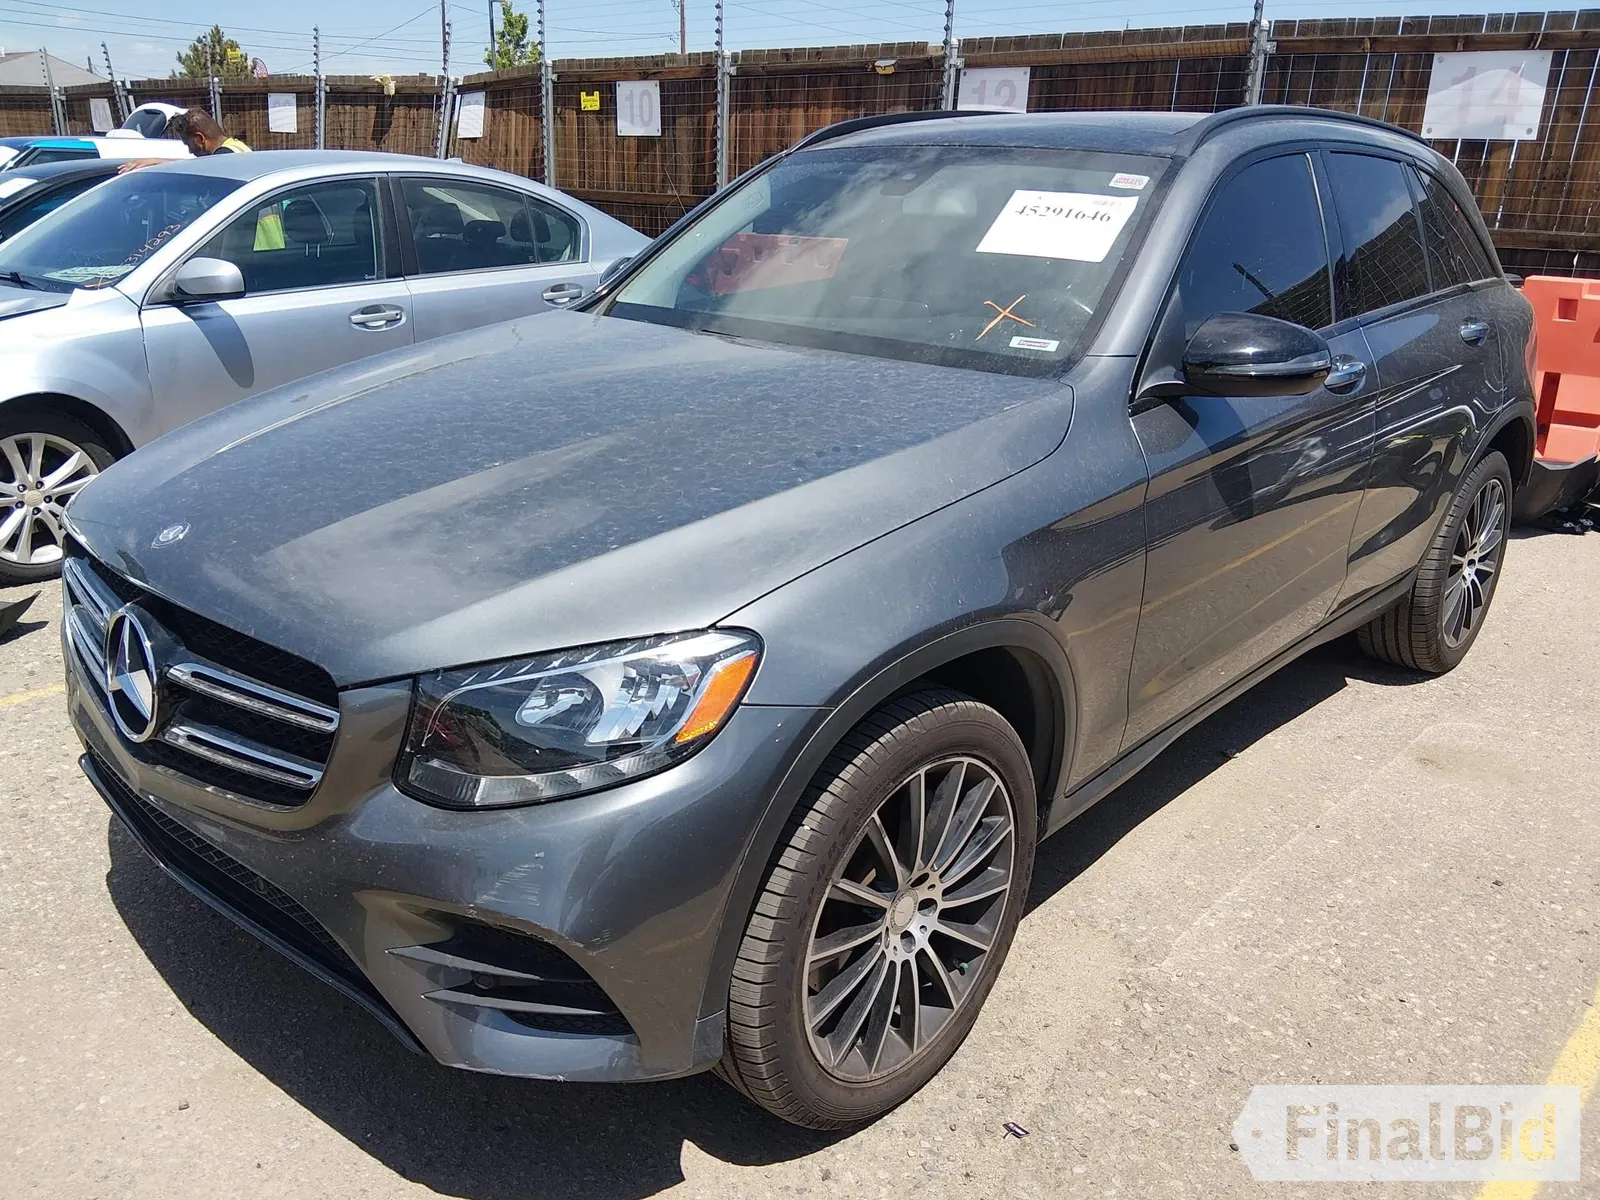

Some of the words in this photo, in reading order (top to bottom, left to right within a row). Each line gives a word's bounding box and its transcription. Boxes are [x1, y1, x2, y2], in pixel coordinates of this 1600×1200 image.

[625, 89, 653, 128] 10
[972, 79, 1016, 107] 12
[1451, 66, 1523, 125] 14
[1014, 204, 1111, 222] 45291646
[121, 224, 181, 266] 314293
